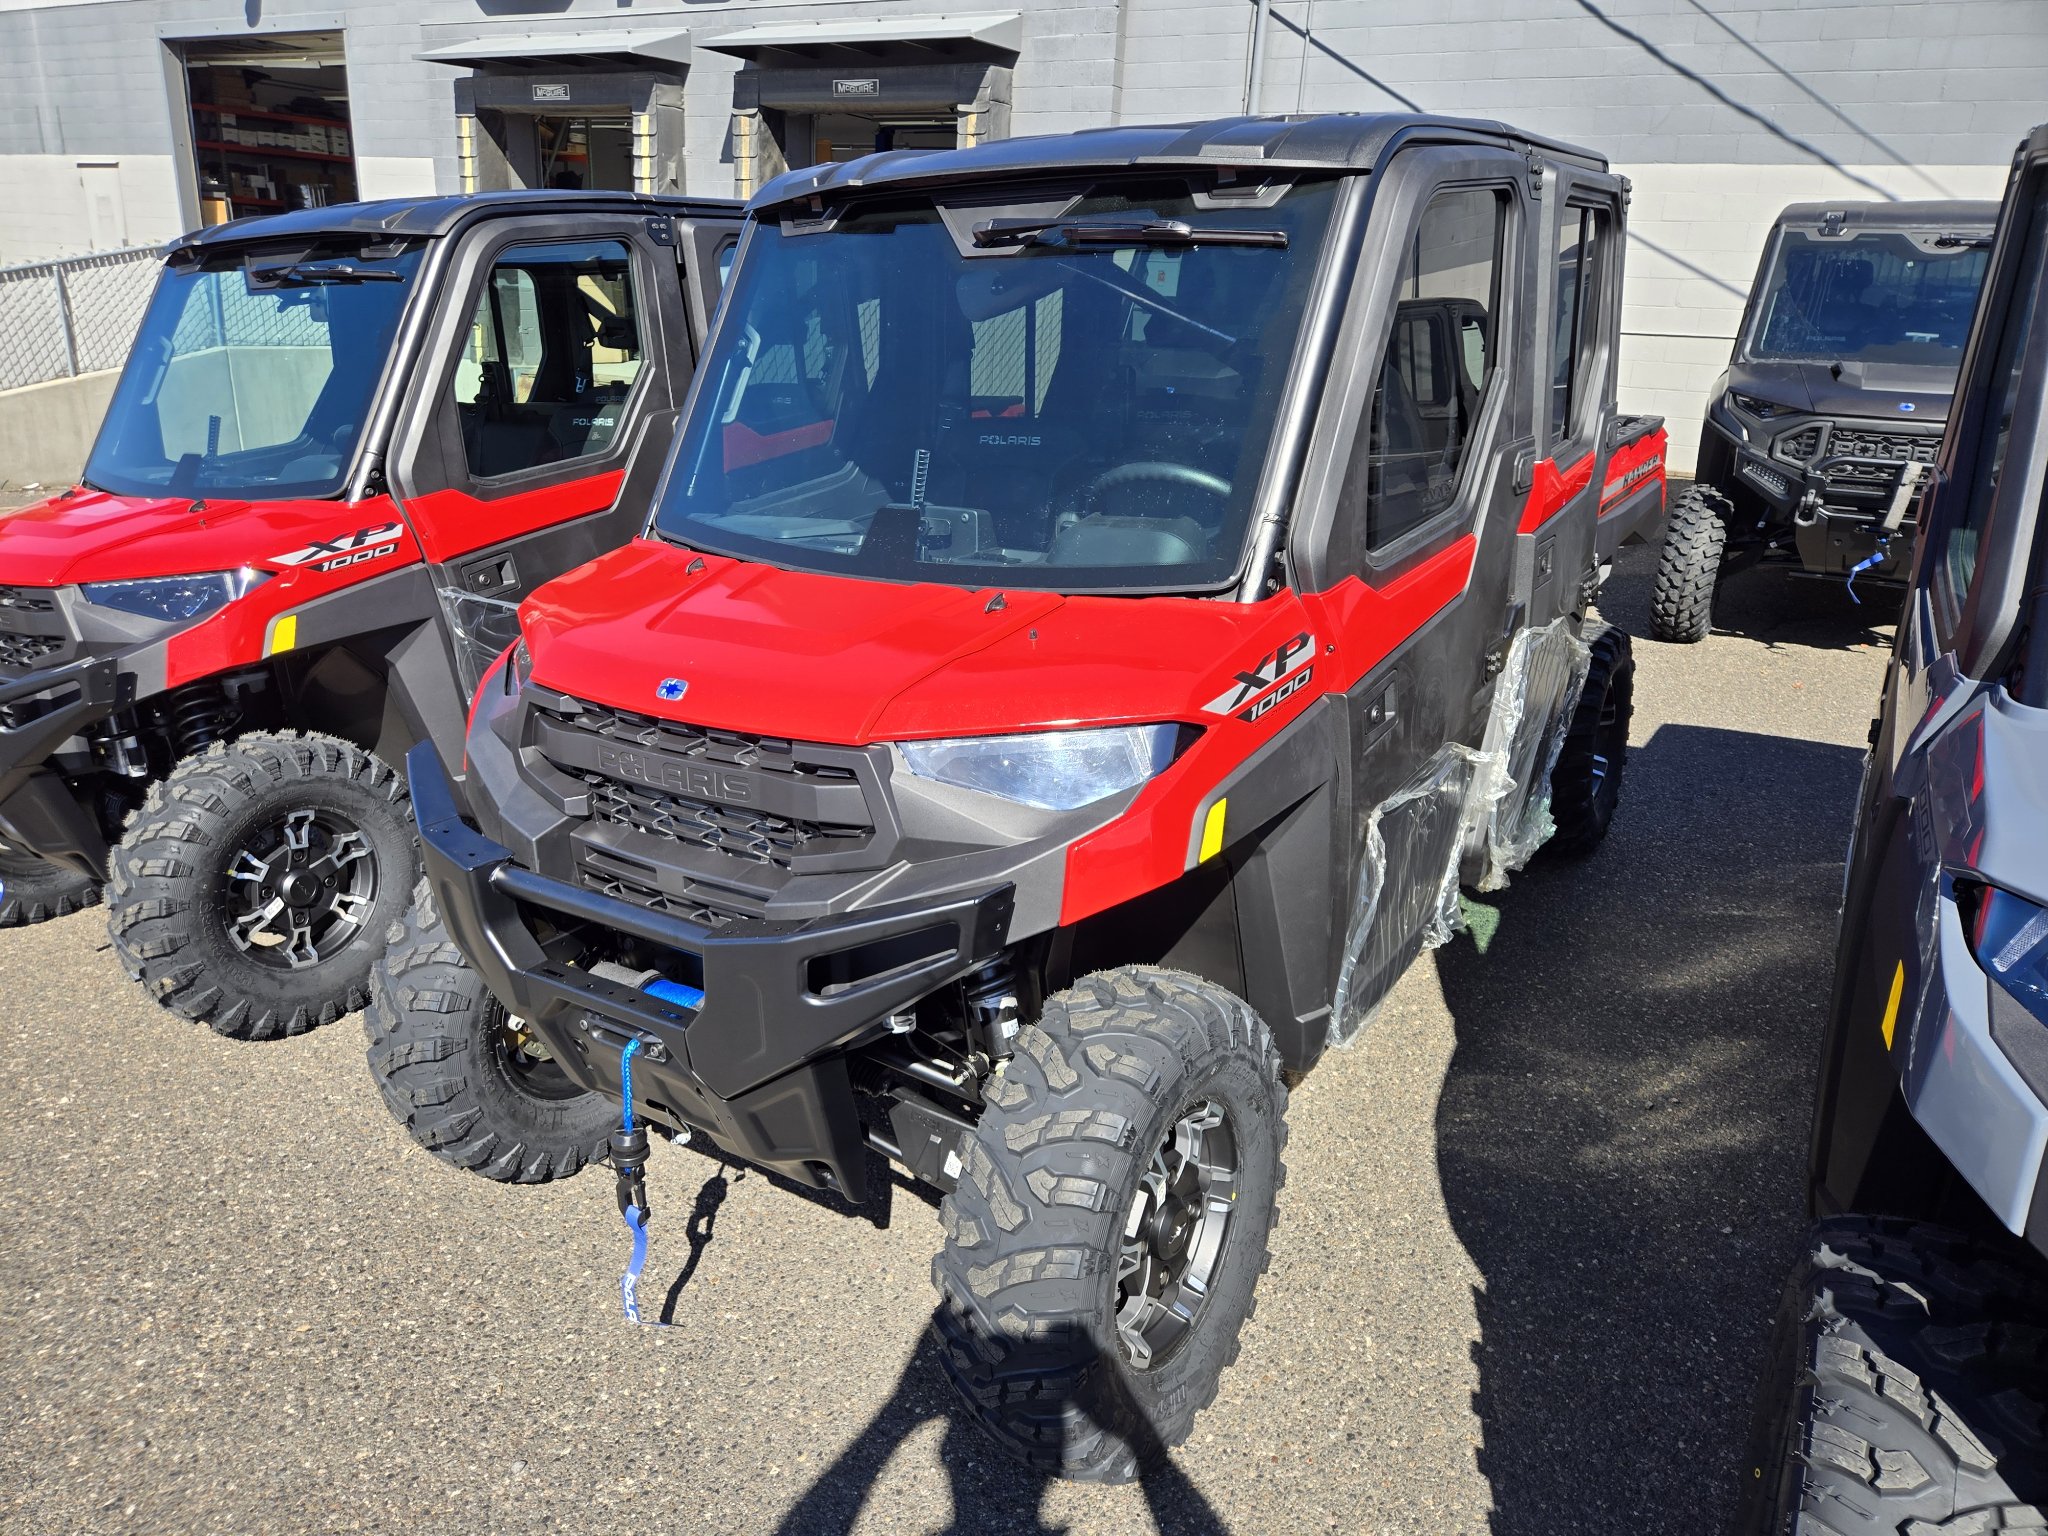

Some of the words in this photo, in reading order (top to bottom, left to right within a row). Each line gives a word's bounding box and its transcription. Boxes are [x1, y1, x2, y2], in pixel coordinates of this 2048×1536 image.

[572, 417, 614, 426] POLARIS
[980, 435, 1041, 446] POLARIS
[295, 521, 398, 564] XP
[322, 543, 396, 573] 1000
[1227, 631, 1311, 713] XP
[1250, 668, 1311, 722] 1000
[597, 745, 752, 803] POLARIS
